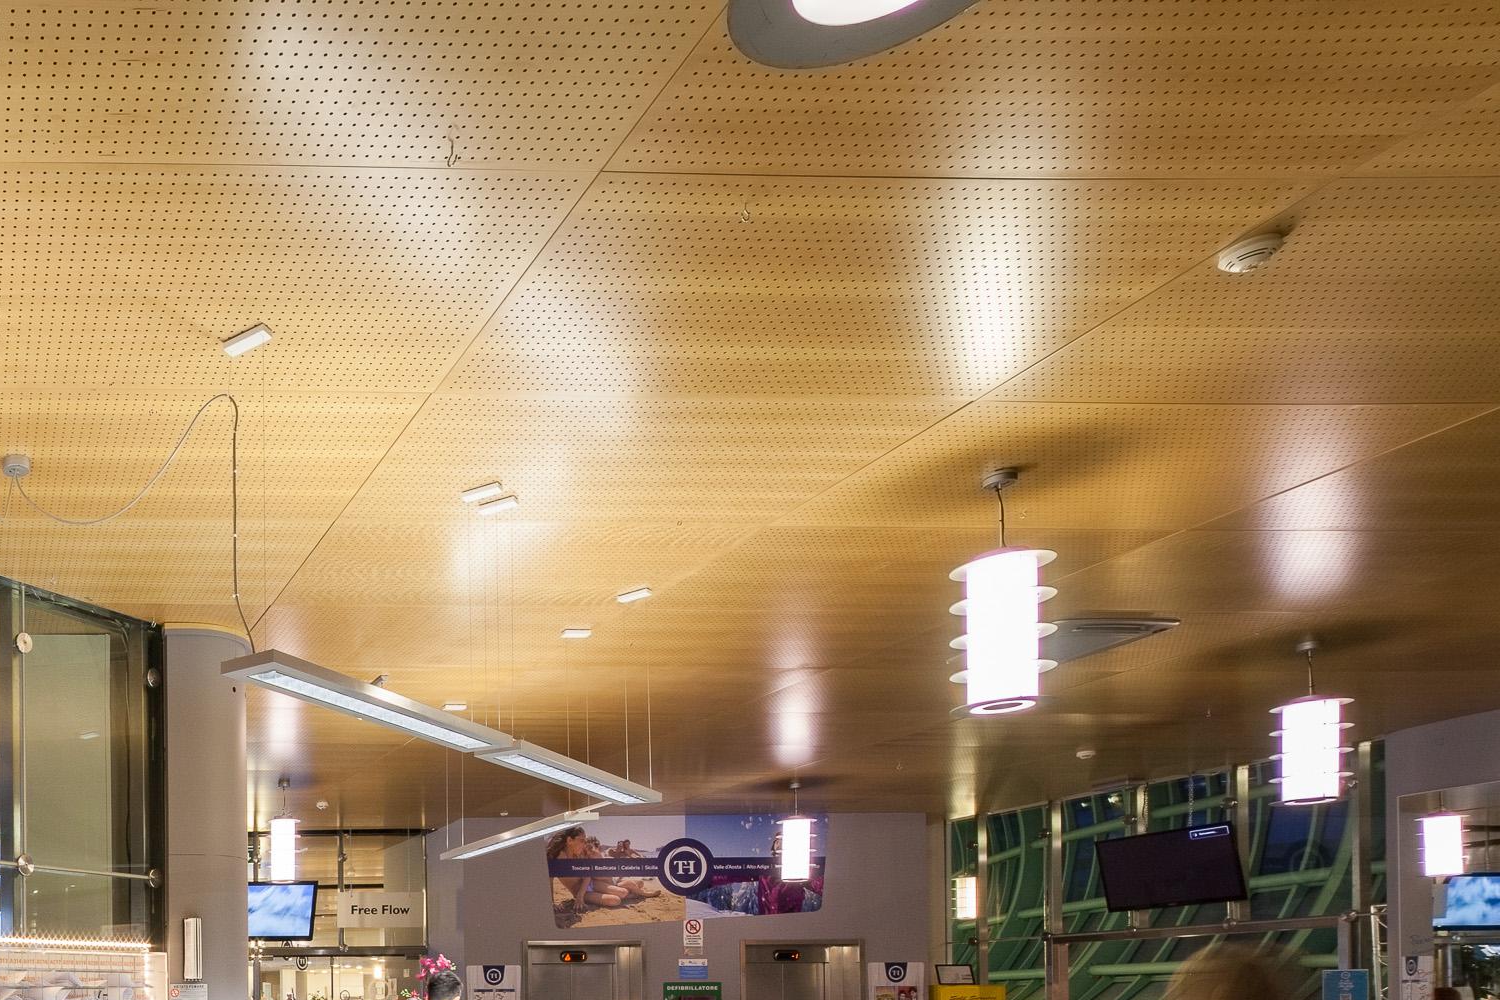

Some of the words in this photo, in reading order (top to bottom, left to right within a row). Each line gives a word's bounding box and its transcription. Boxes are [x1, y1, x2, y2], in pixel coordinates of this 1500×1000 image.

[673, 860, 696, 875] TH
[351, 904, 378, 915] Free
[381, 904, 411, 915] Flow
